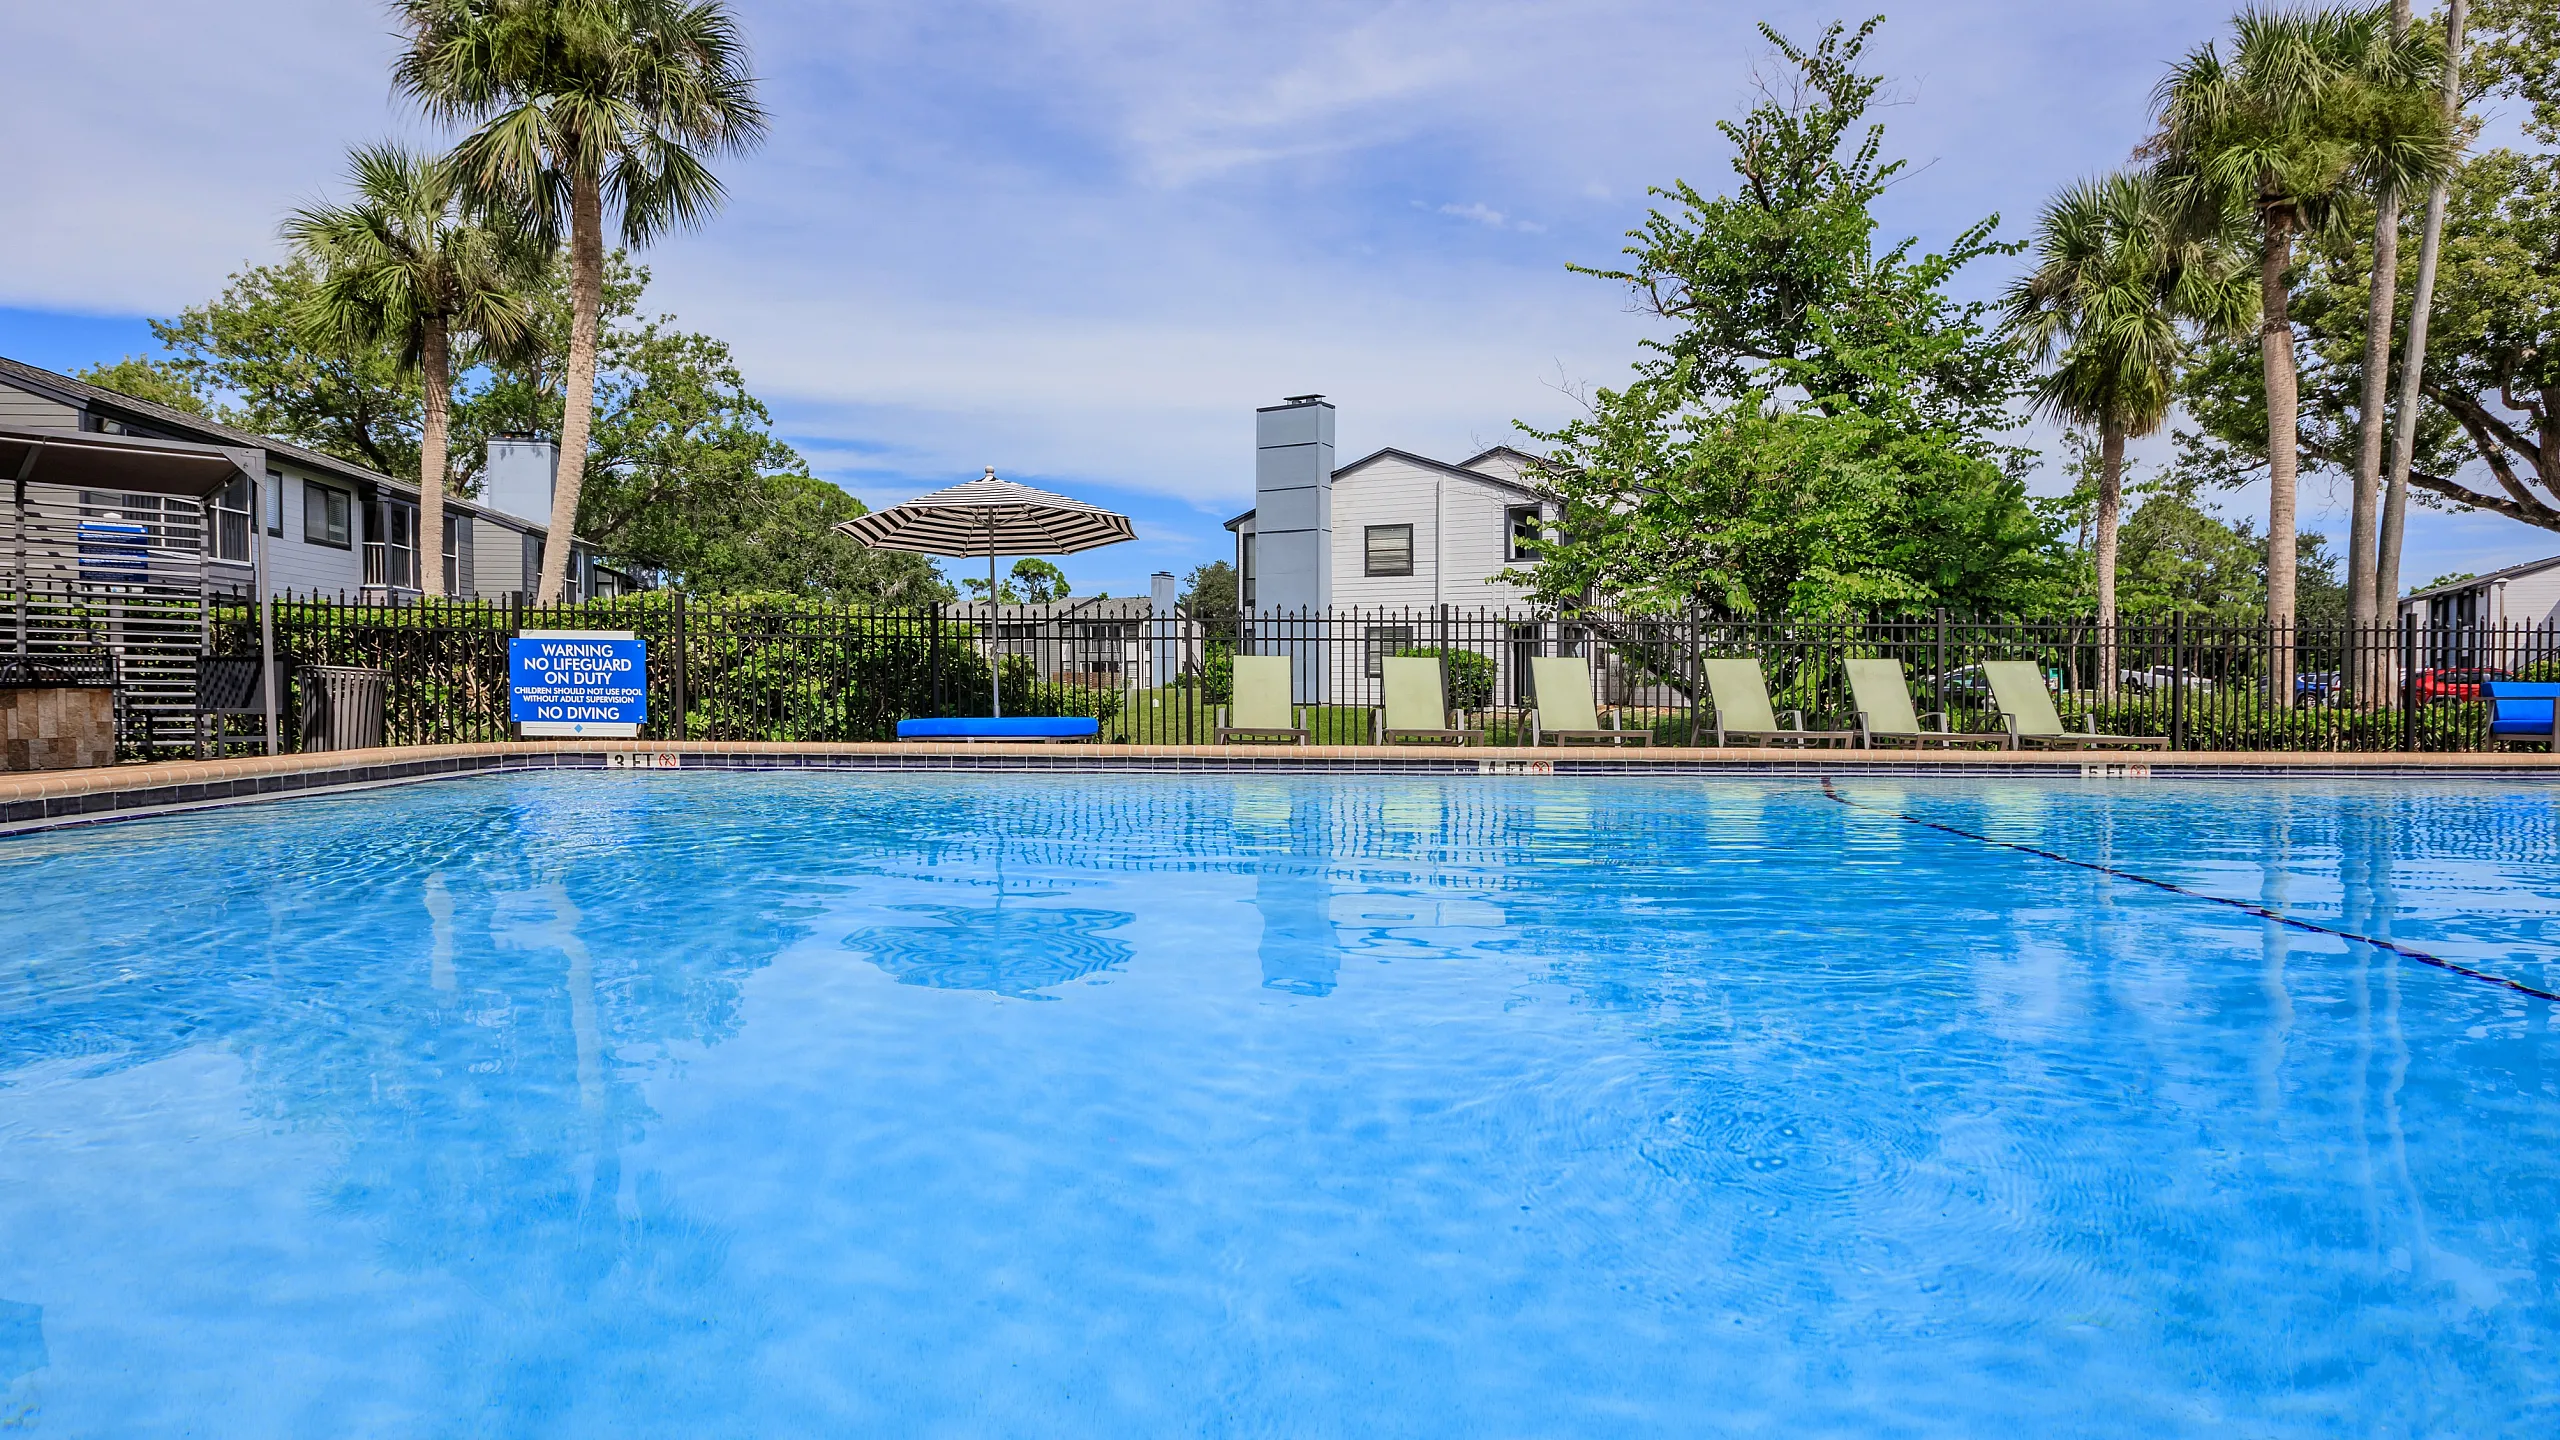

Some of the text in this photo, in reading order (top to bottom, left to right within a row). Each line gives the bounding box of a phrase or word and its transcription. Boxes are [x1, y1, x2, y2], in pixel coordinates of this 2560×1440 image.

[541, 643, 614, 658] WARNING
[524, 657, 632, 672] NO LIFEGUARD
[544, 671, 613, 685] ON DUTY
[514, 686, 643, 696] CHILDREN SHOULD NOT USE POOL
[523, 694, 634, 704] WITHOUT ADULT SUPERVISION
[537, 706, 620, 720] NO DIVING
[614, 753, 654, 767] 3 FT
